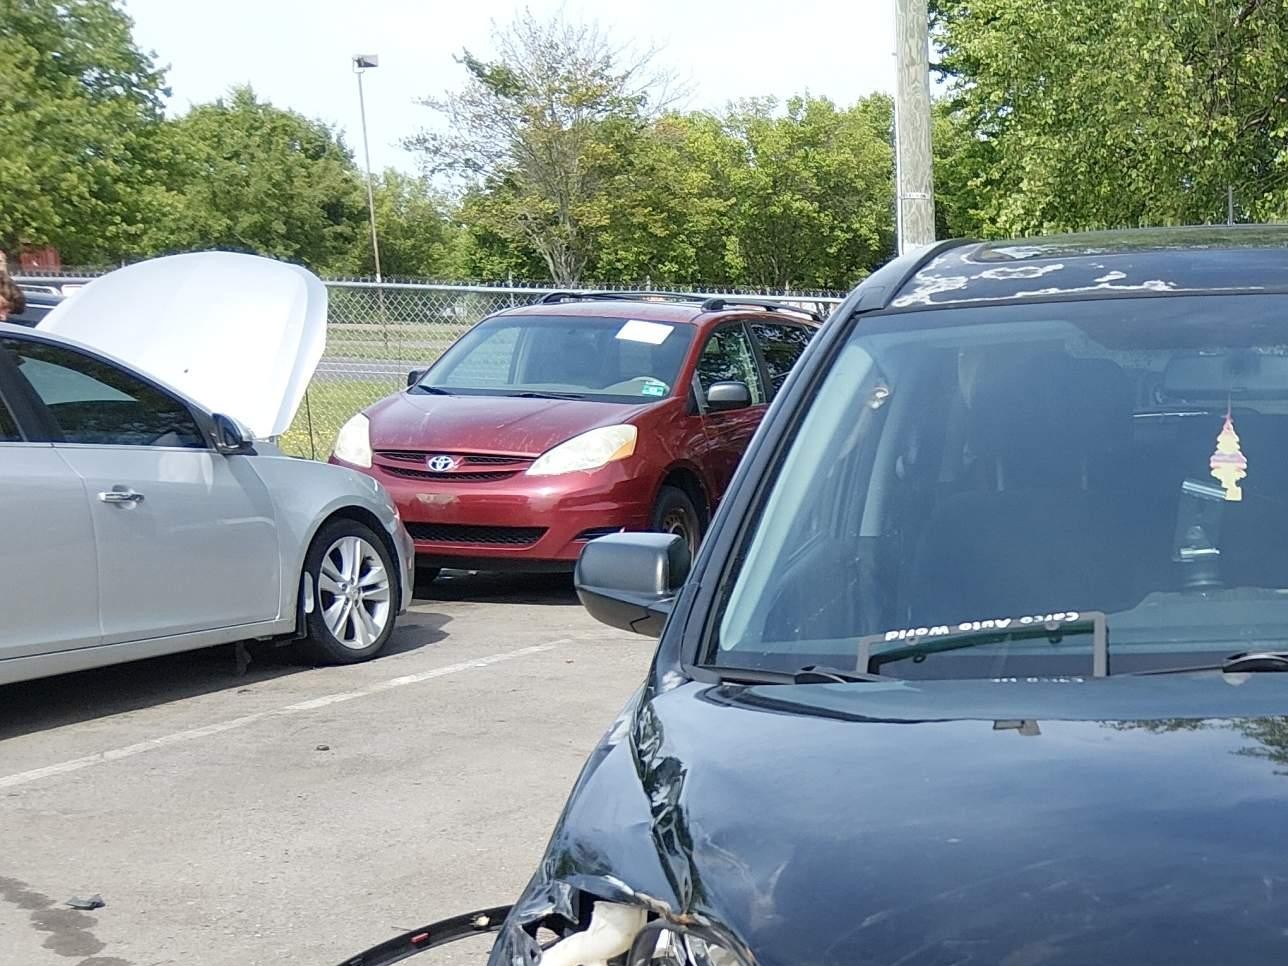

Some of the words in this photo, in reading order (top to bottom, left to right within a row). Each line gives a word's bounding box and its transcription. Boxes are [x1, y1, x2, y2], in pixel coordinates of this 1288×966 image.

[958, 618, 1011, 632] Auto
[1019, 611, 1080, 625] Carco
[884, 625, 950, 641] World
